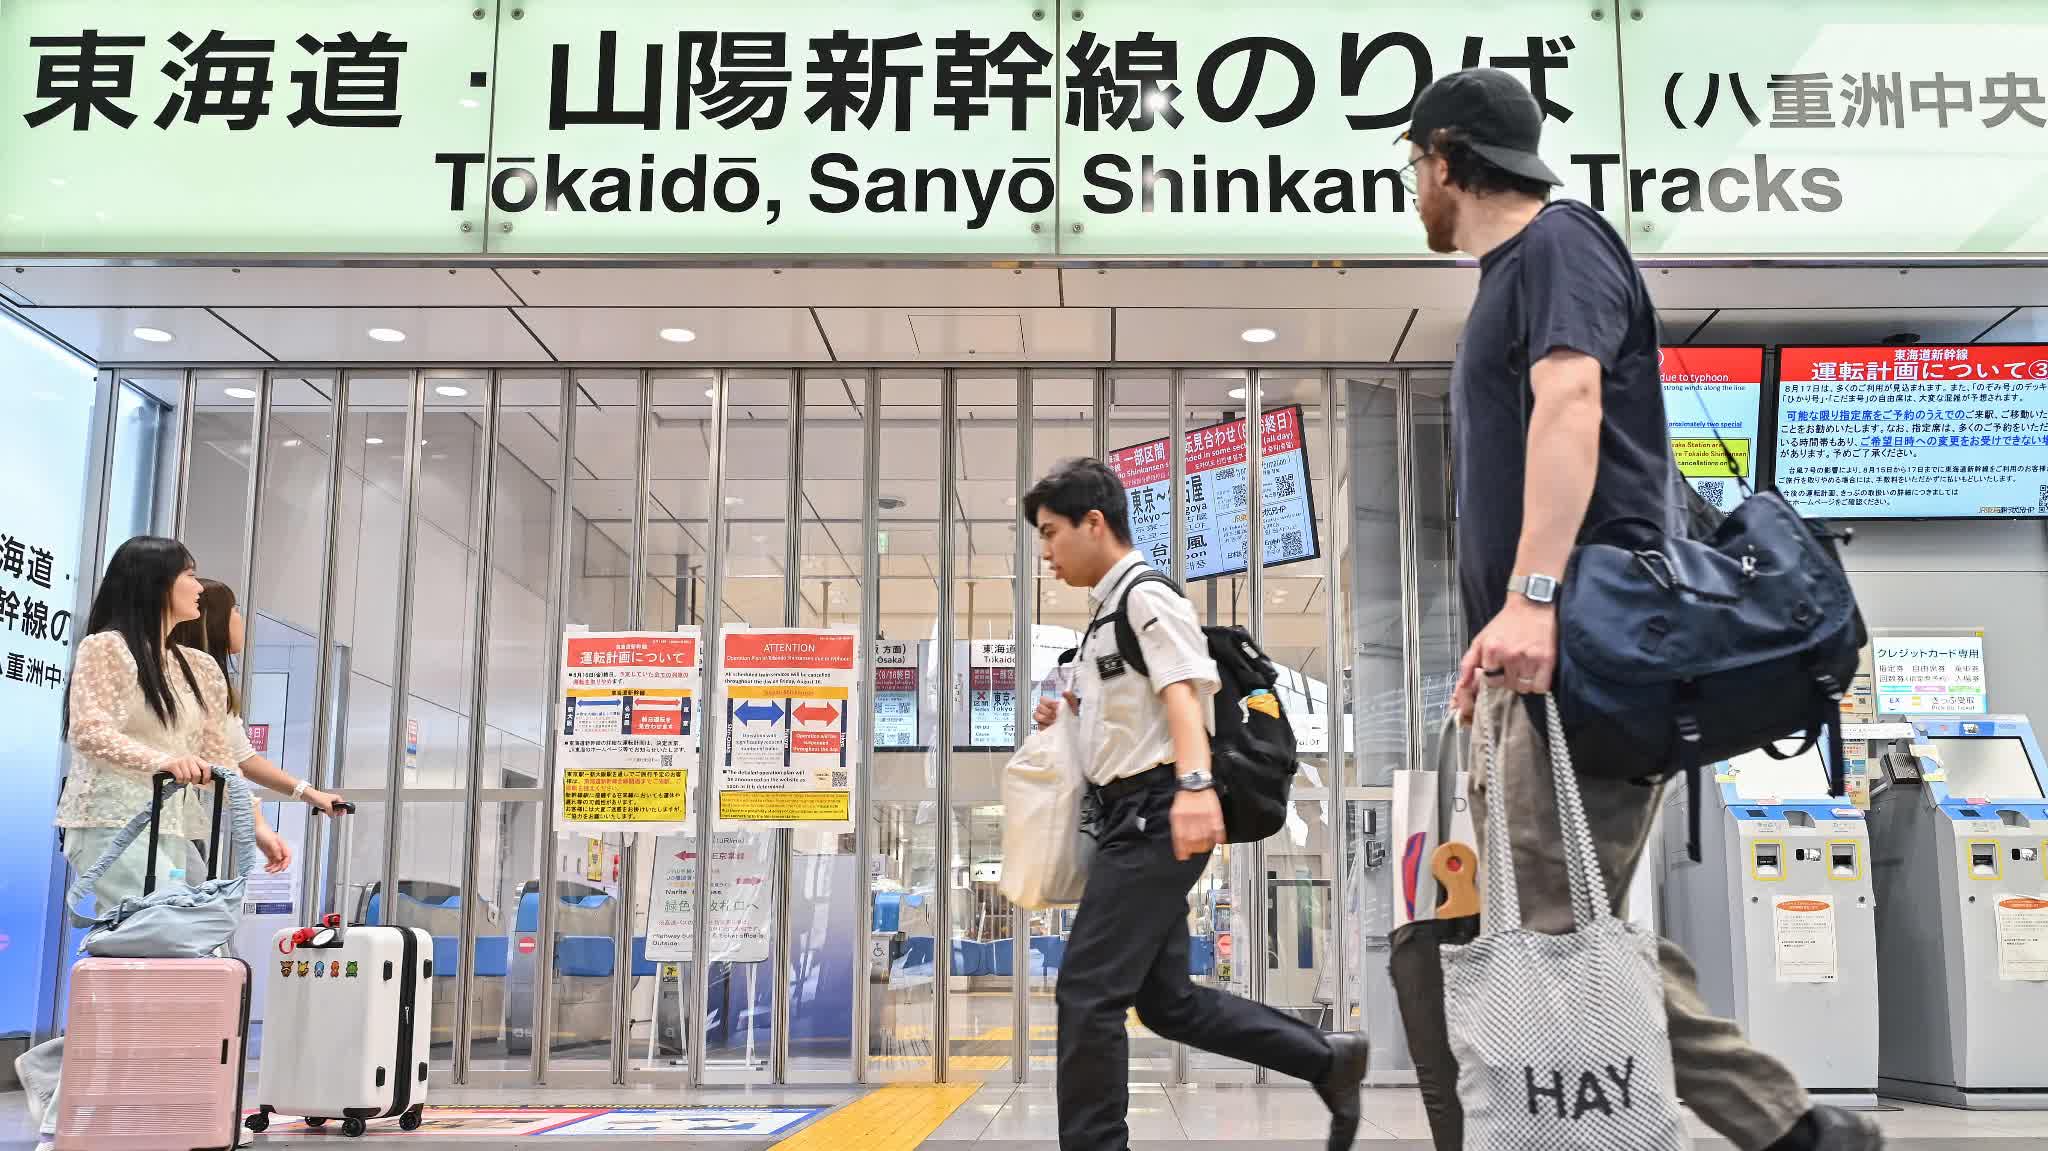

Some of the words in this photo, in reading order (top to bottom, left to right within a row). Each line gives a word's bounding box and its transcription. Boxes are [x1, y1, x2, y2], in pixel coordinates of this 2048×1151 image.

[435, 153, 781, 225] Tōkaidō,
[809, 153, 1054, 229] Sanyō
[1083, 154, 1405, 213] Shinkan
[1571, 153, 1844, 213] Tracks
[1894, 349, 1969, 361] 東海道新幹線
[763, 643, 815, 653] ATTENTION
[1878, 648, 1980, 659] クレジットカード専用
[579, 651, 685, 665] 運転計画について
[1524, 1056, 1635, 1120] HAY
